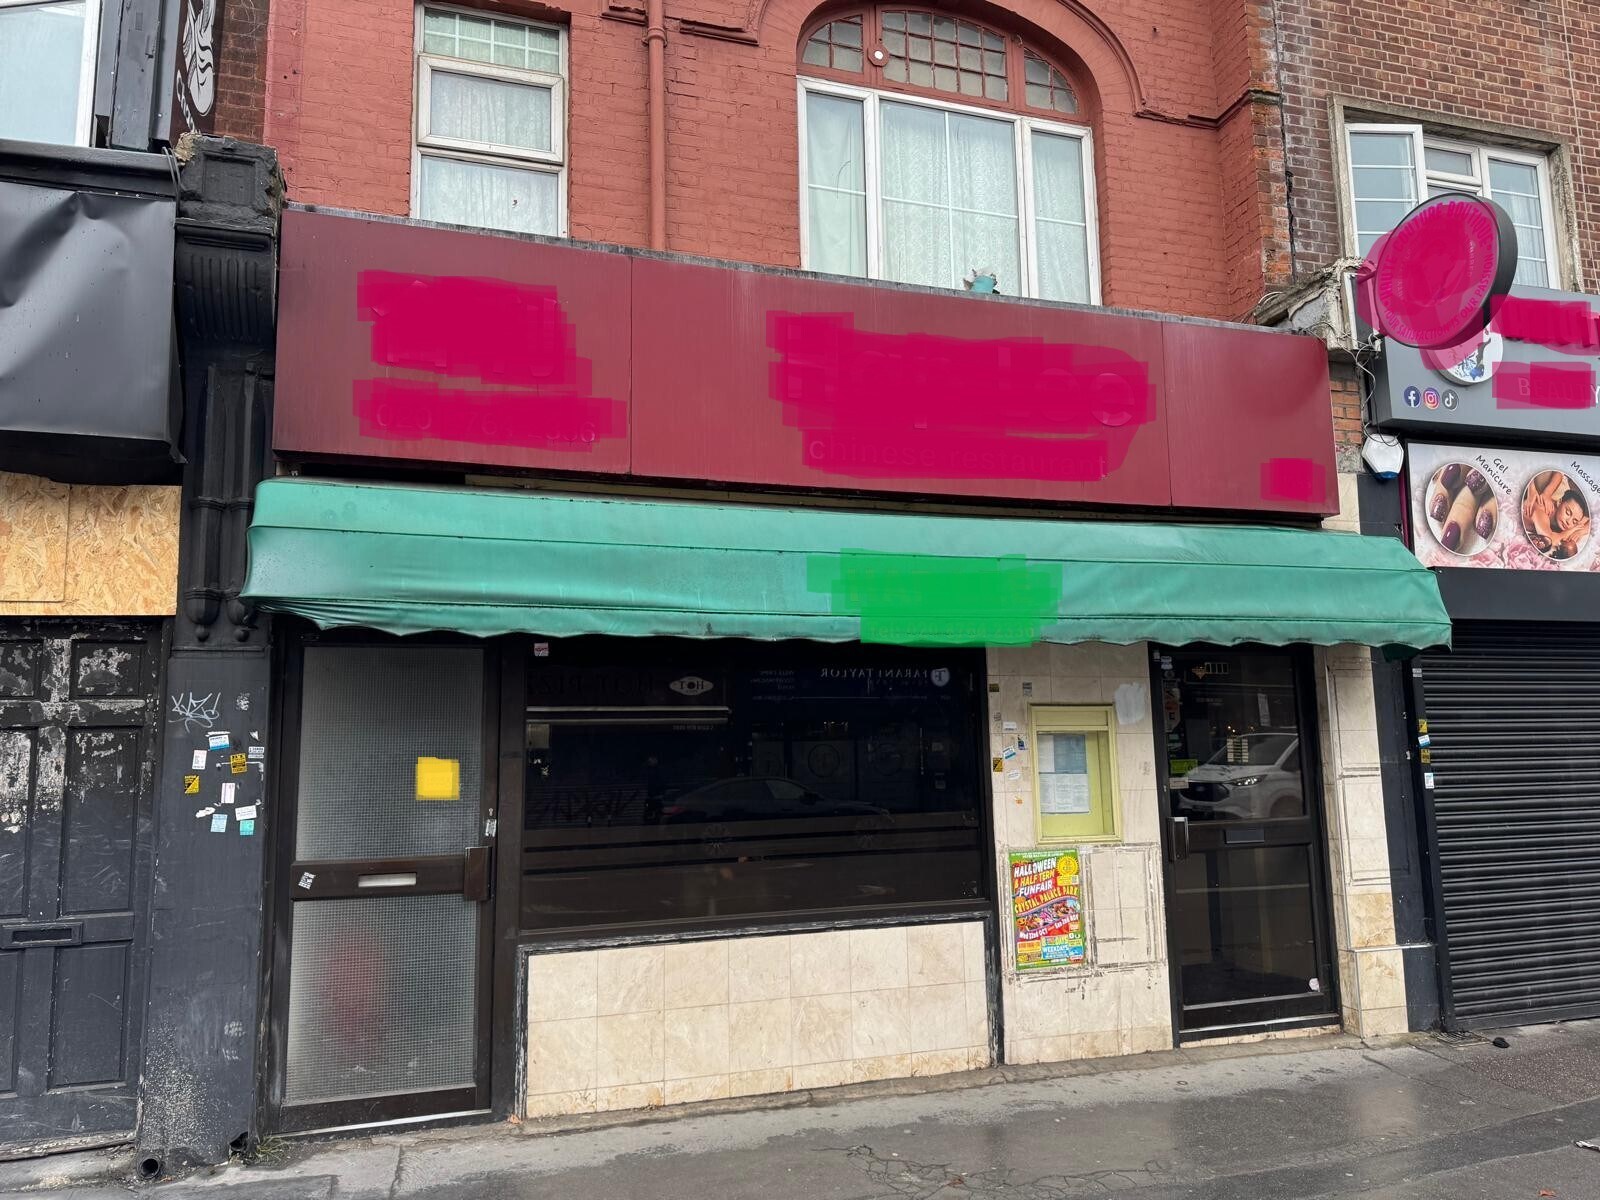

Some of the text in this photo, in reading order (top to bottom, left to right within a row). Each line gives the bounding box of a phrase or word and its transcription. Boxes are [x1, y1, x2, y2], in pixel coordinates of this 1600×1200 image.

[1459, 296, 1479, 318] OUR
[1475, 455, 1512, 495] Manicure
[1493, 458, 1509, 474] Gel
[1014, 857, 1057, 878] HALLOWEEN
[1019, 880, 1053, 897] FUNFAIR
[1021, 874, 1038, 887] HALF
[1015, 885, 1078, 911] CRYSTAL PALACE PARK
